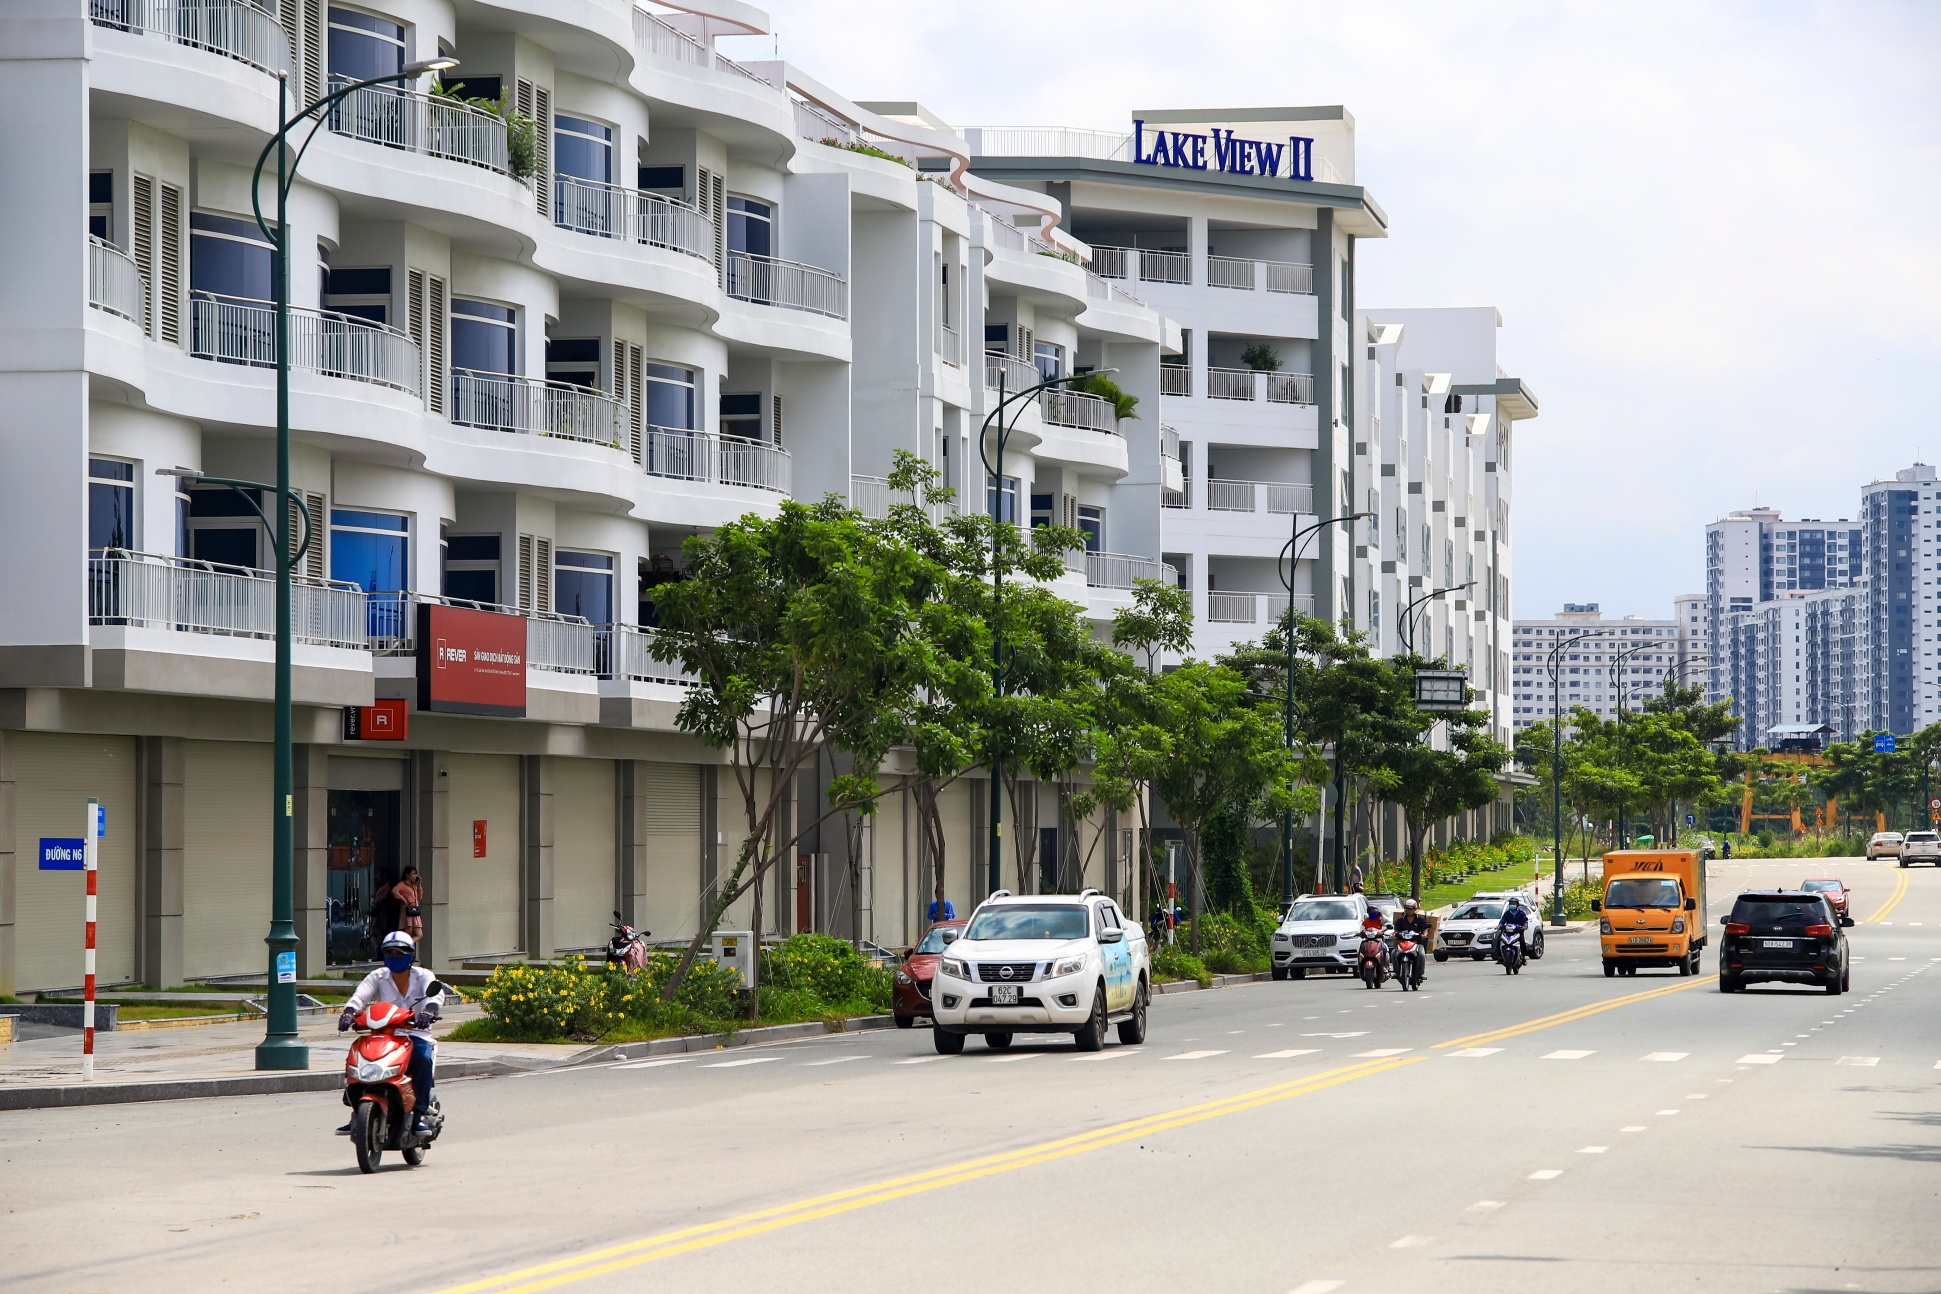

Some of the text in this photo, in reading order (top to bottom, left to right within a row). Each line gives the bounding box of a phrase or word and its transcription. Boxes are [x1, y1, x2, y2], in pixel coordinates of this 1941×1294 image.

[1134, 120, 1314, 181] LAKE VIEW II
[376, 715, 388, 725] R
[45, 845, 82, 861] ĐƯỜNG N6
